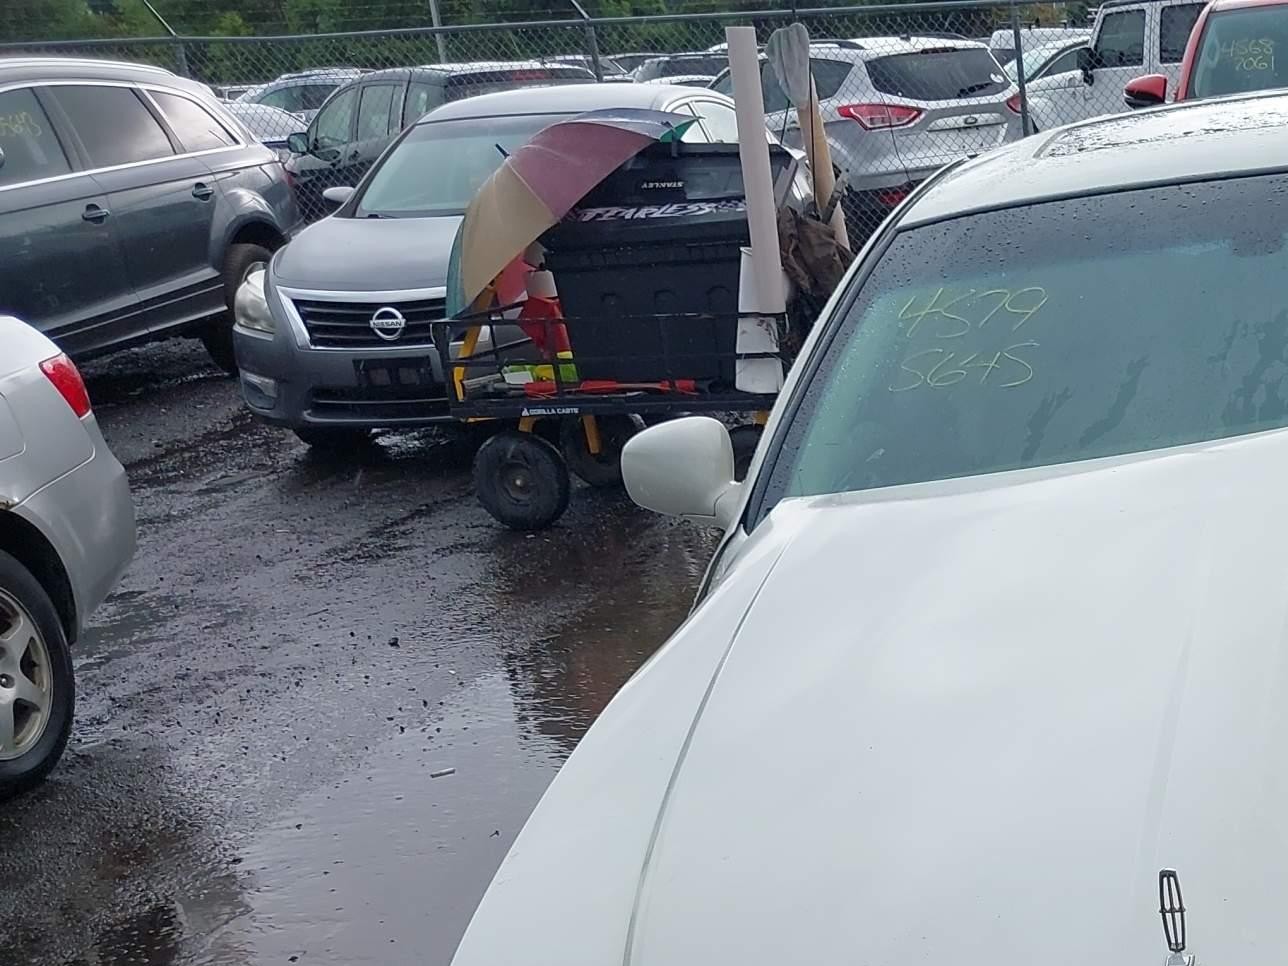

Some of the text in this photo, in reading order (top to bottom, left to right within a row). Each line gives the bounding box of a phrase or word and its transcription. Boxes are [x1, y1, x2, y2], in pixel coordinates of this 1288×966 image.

[641, 181, 685, 189] STANLEY
[372, 320, 402, 328] NISSAN
[898, 286, 1049, 339] 4579
[887, 340, 1041, 392] 5645
